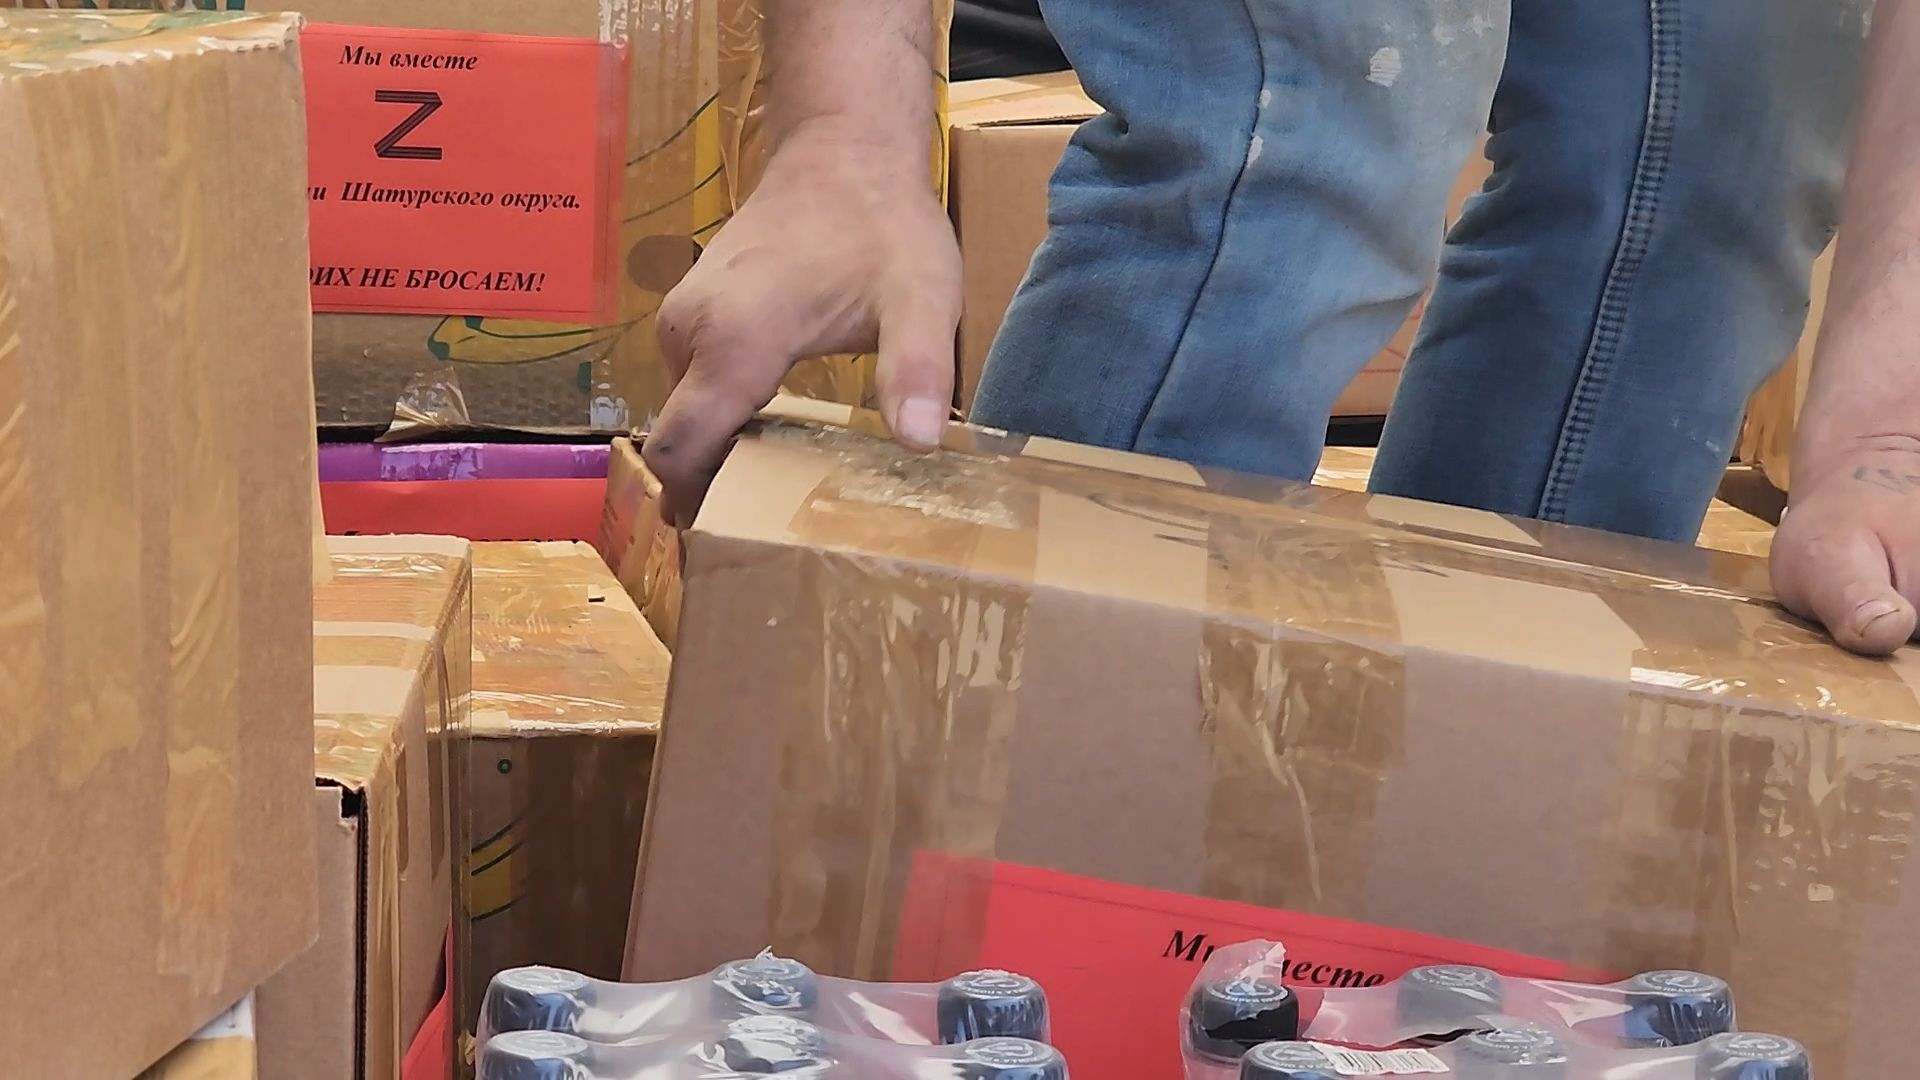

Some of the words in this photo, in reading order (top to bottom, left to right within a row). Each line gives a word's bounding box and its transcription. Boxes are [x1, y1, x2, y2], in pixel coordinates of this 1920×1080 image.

[340, 45, 381, 66] Мы
[389, 53, 478, 70] вместе
[374, 90, 442, 160] Z
[307, 187, 327, 201] и
[341, 182, 494, 209] Шатурского
[500, 193, 580, 212] округа.
[359, 267, 399, 288] НЕ
[405, 269, 546, 292] БРОСАЕМ!
[1163, 930, 1214, 964] М
[1281, 959, 1385, 988] есте
